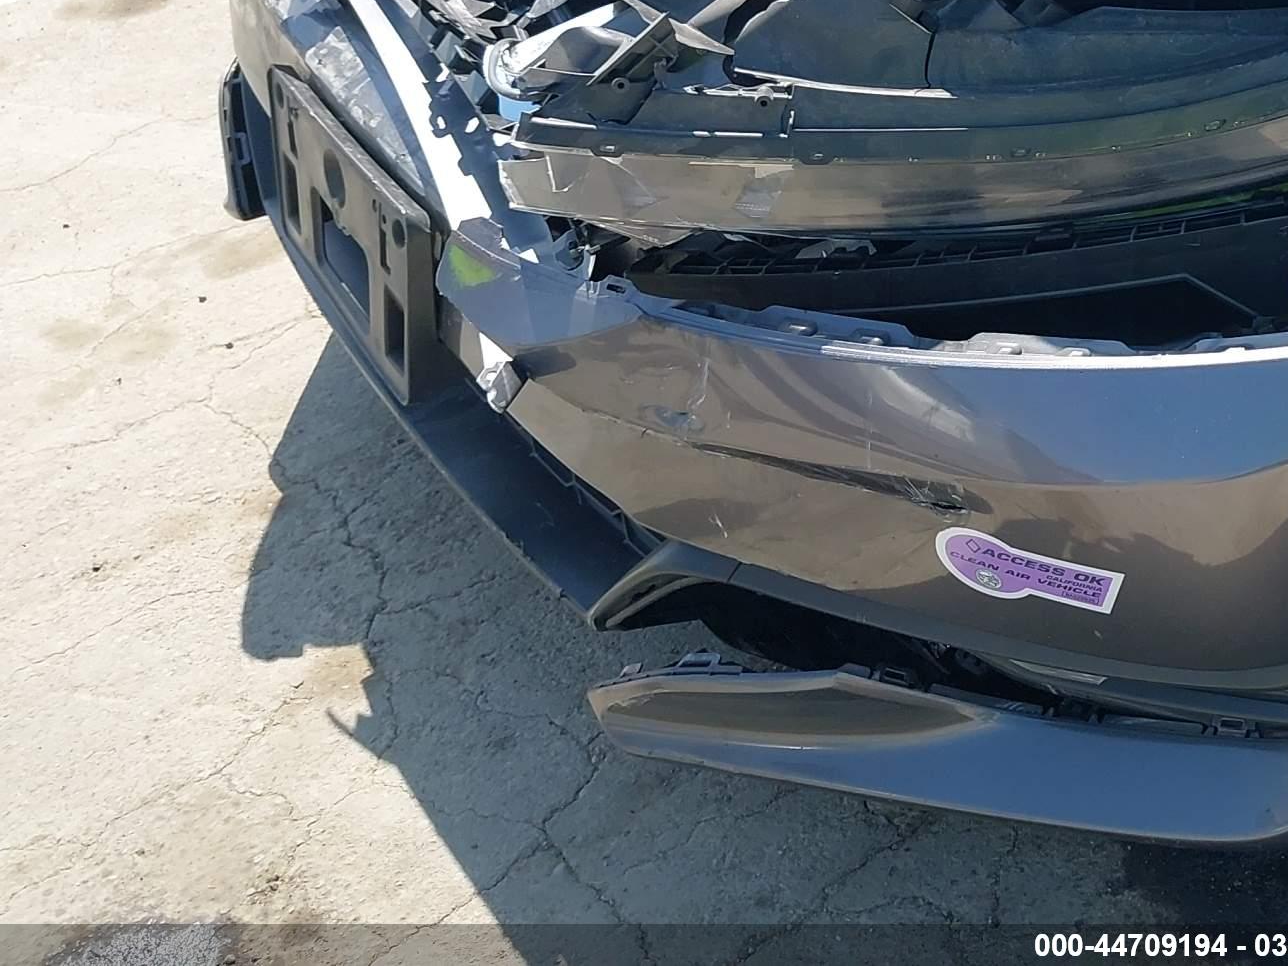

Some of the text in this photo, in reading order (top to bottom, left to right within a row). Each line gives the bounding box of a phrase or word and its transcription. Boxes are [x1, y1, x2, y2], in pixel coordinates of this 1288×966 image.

[950, 551, 1102, 598] CLEAN AIR VEHICLE
[981, 547, 1105, 587] ACCESS OK
[1046, 575, 1103, 593] CALIFORNIA
